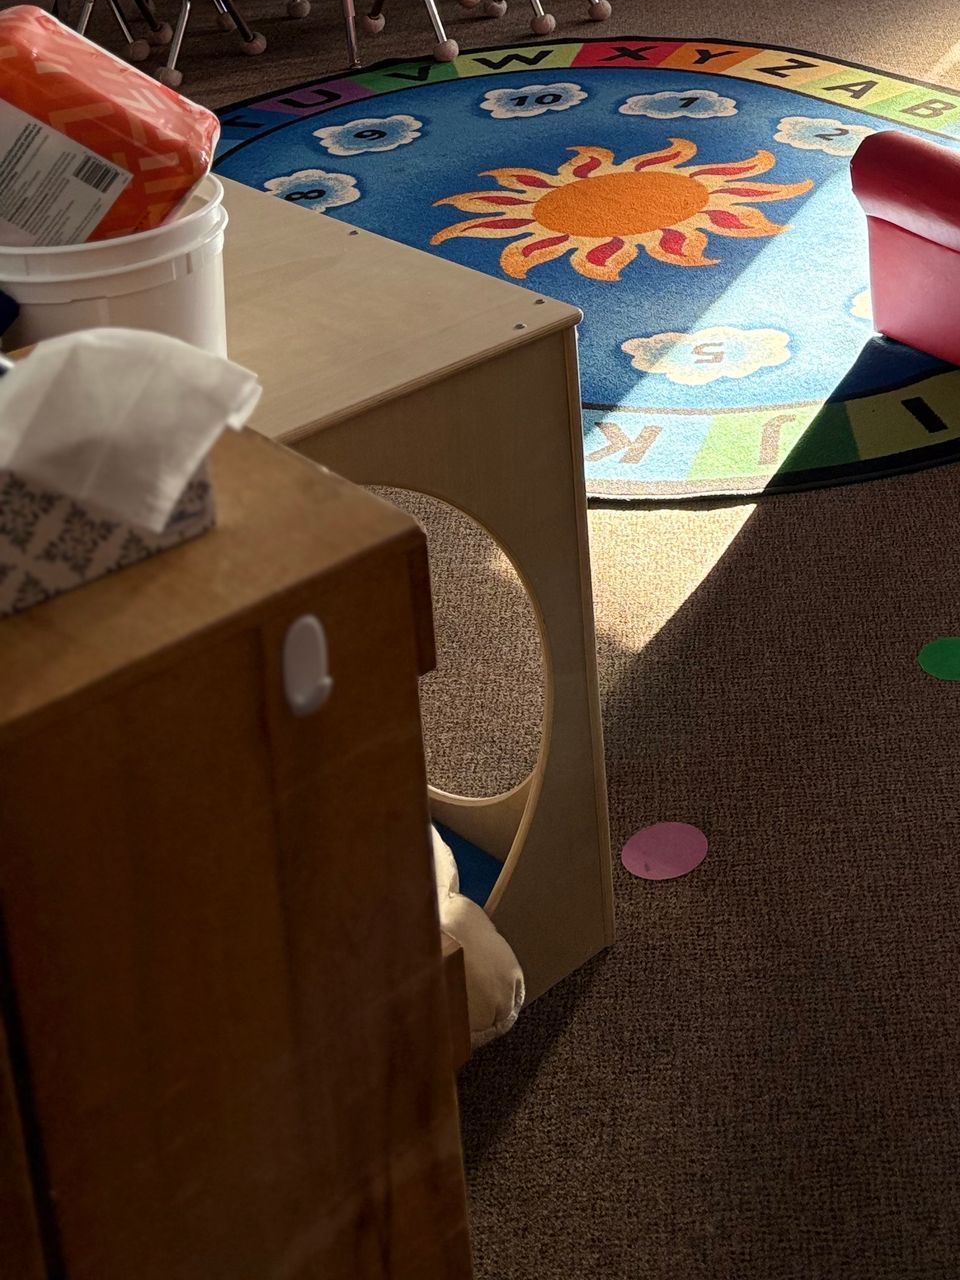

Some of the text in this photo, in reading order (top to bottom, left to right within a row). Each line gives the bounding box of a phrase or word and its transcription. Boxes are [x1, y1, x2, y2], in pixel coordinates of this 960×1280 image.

[278, 88, 342, 109] U
[383, 64, 434, 82] V
[471, 49, 555, 70] W
[602, 46, 658, 61] X
[692, 48, 738, 64] Y
[755, 58, 818, 78] Z
[824, 80, 878, 100] A
[900, 98, 956, 119] B
[511, 92, 563, 107] 10
[678, 96, 699, 108] 1
[353, 128, 388, 141] 9
[814, 128, 849, 141] 2
[285, 188, 326, 202] 8
[691, 341, 725, 364] 5
[585, 397, 948, 465] K J I
